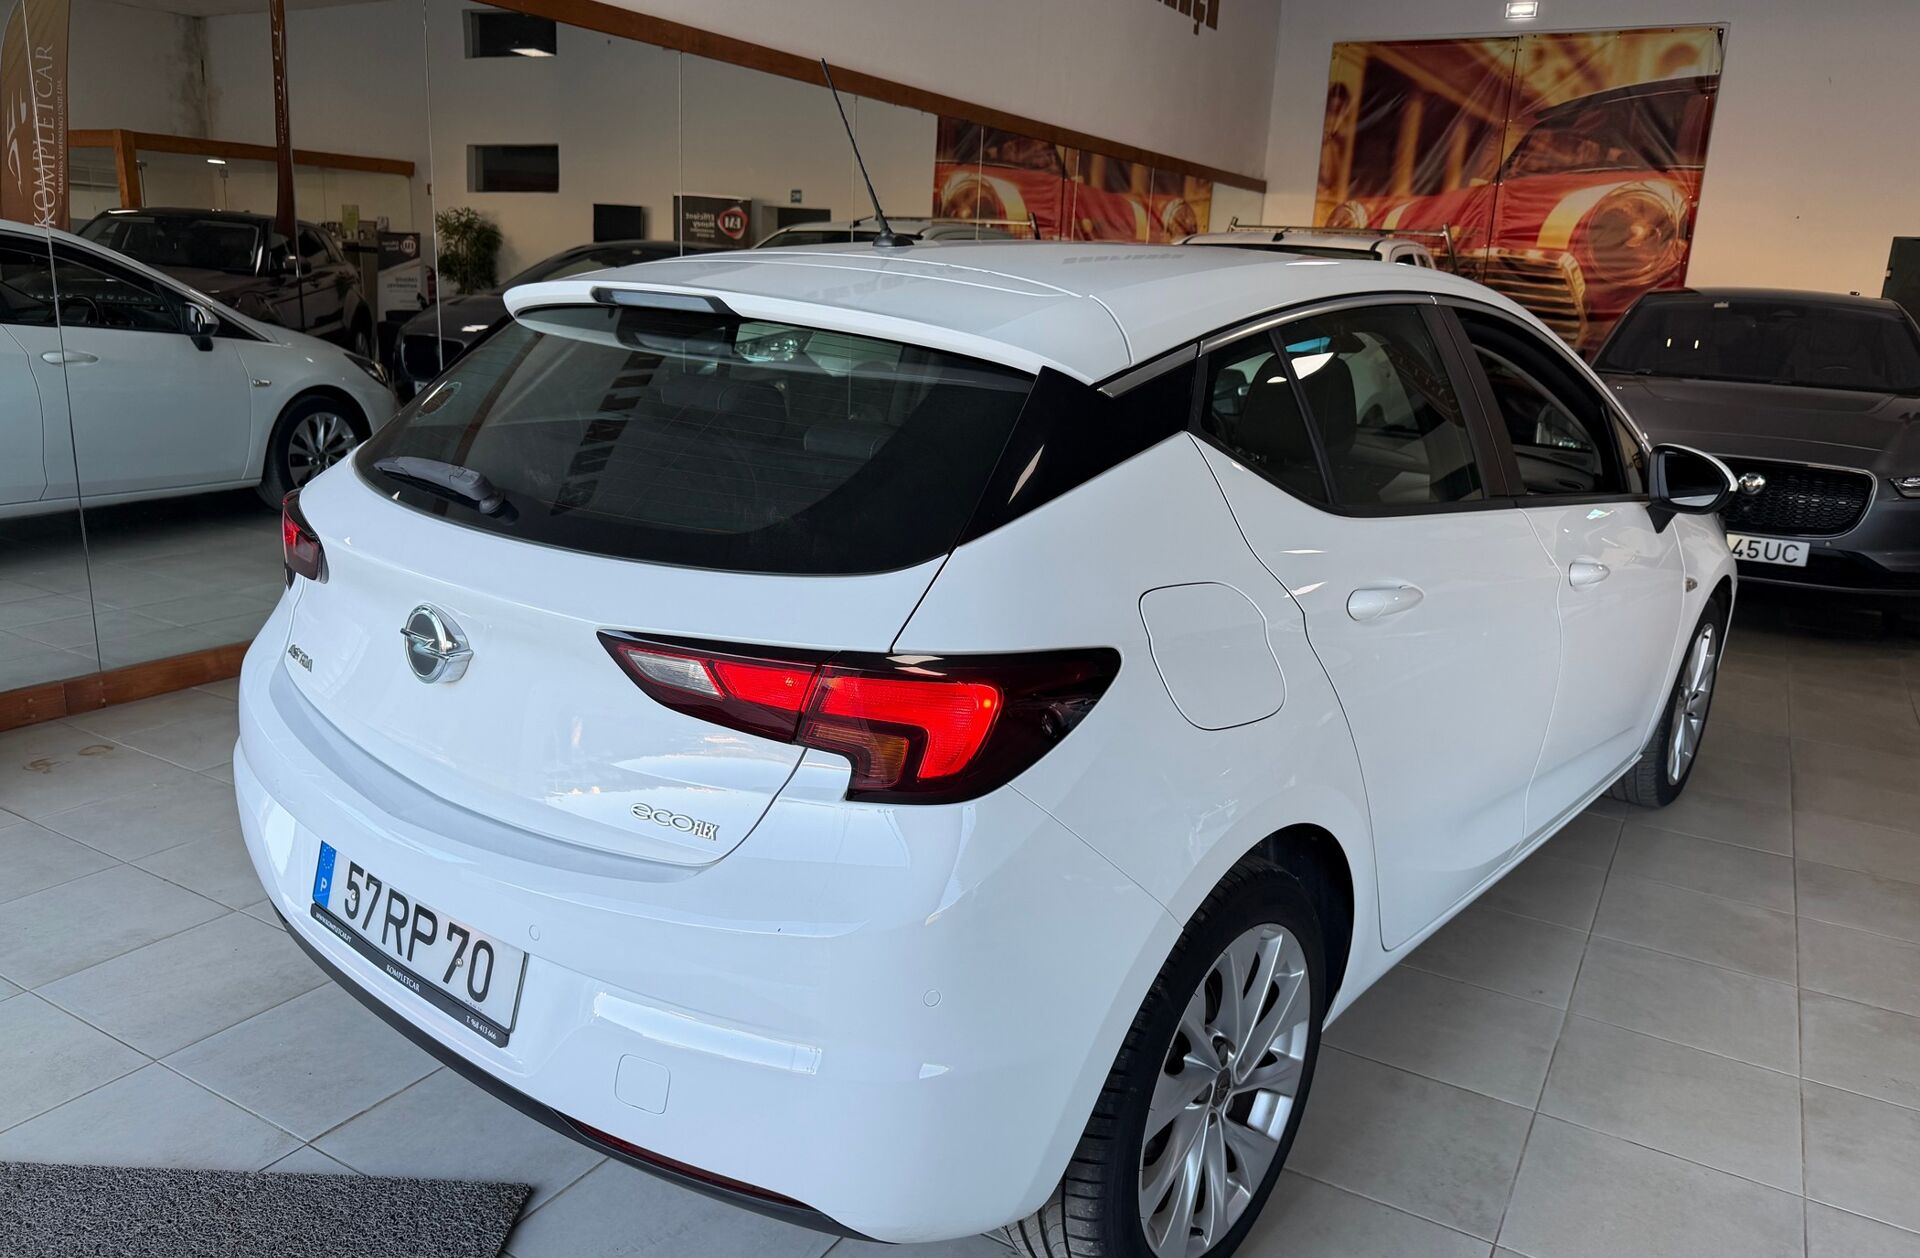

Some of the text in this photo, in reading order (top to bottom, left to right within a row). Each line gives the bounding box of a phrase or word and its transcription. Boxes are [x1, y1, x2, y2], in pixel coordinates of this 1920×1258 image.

[32, 43, 56, 228] KOMPLETCAR
[287, 643, 313, 673] ASTRA
[319, 876, 328, 892] P
[386, 963, 420, 993] KOMPLETCAR
